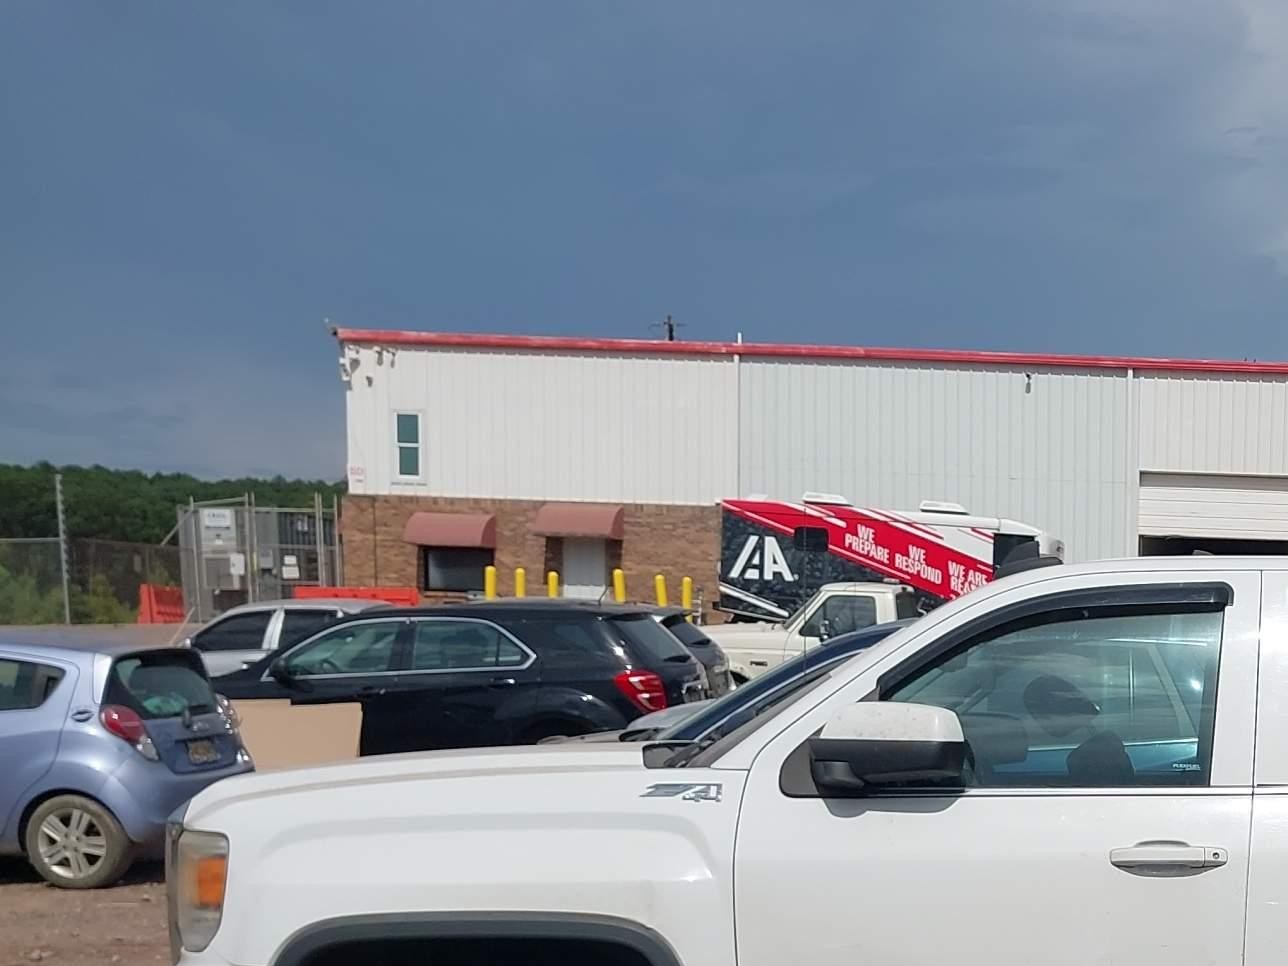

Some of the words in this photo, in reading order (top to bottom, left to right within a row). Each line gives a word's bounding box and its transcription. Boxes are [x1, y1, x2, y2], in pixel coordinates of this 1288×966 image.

[856, 523, 876, 544] WE
[844, 533, 890, 565] PREPARE
[908, 544, 927, 564] WE
[894, 553, 943, 585] RESPOND
[947, 559, 966, 582] WE
